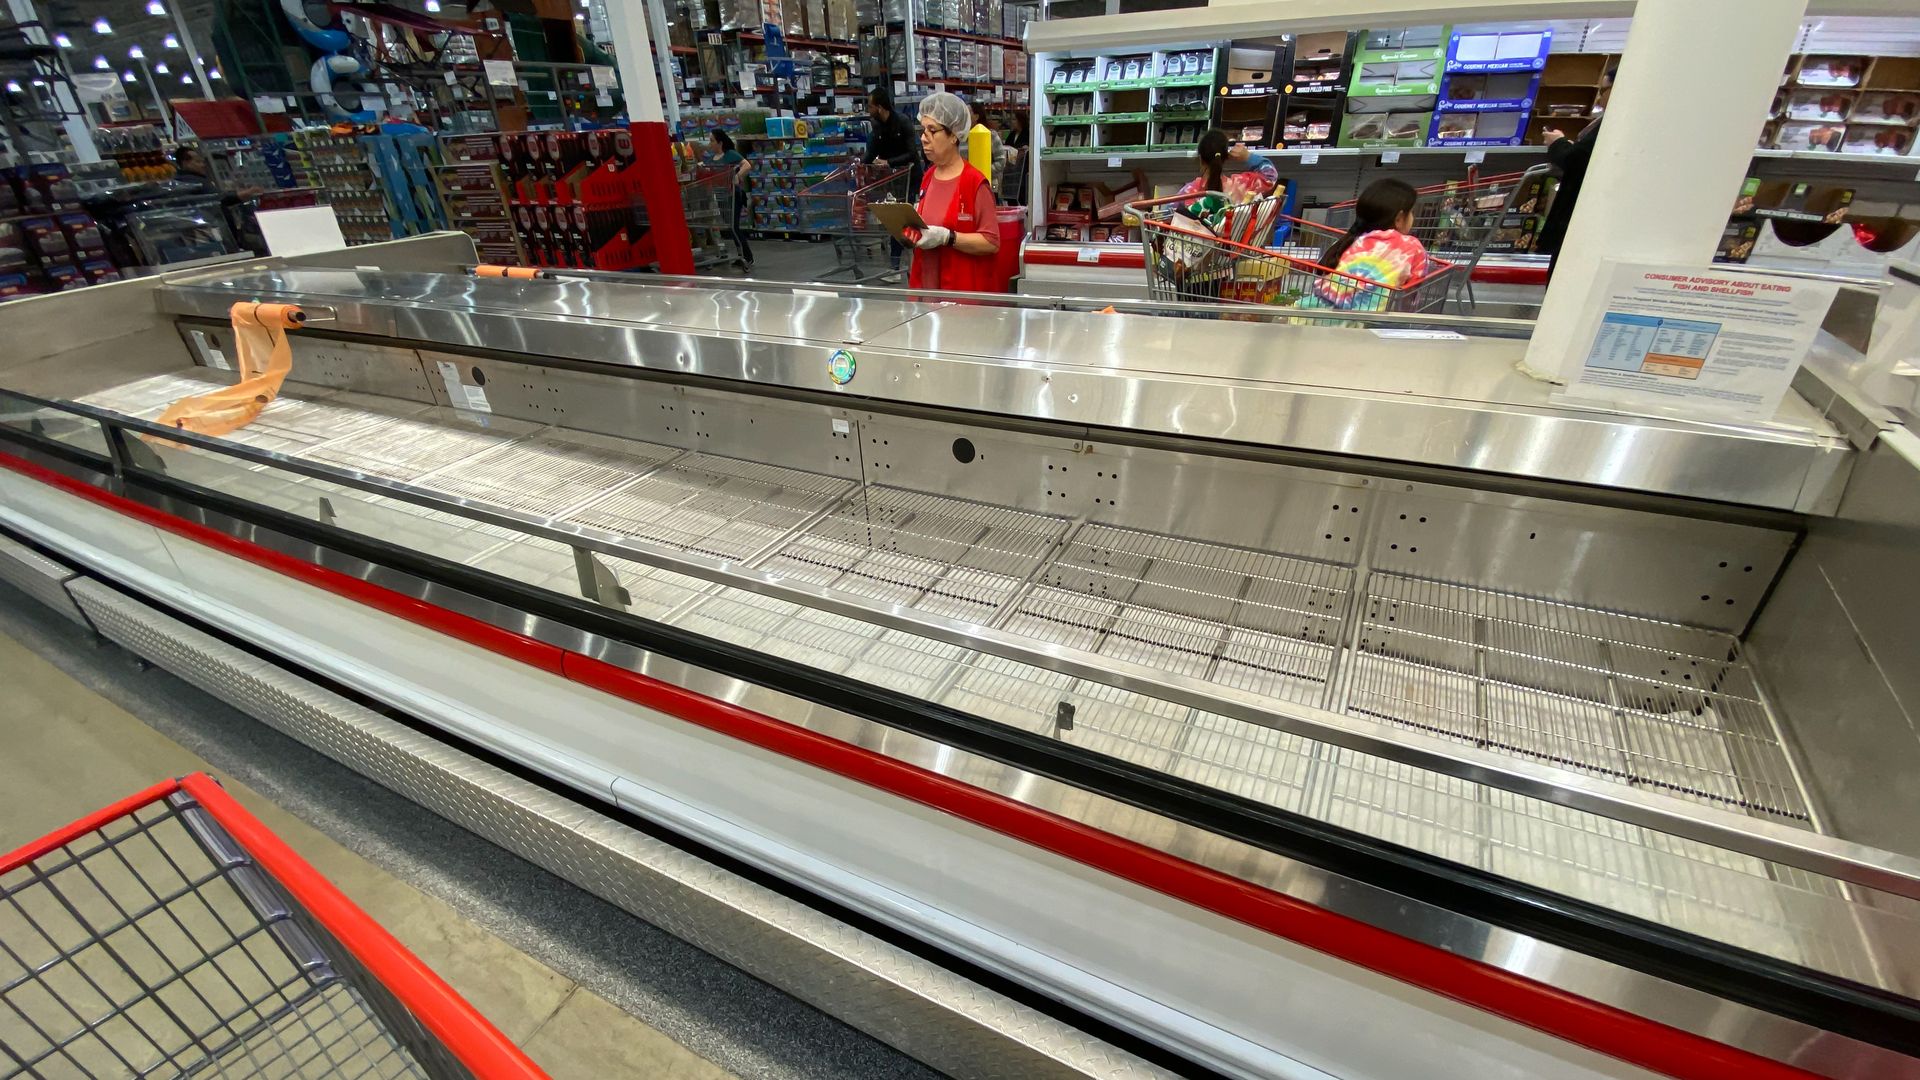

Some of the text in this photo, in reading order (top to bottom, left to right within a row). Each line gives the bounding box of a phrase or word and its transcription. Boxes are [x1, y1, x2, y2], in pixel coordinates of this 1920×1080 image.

[1644, 273, 1791, 293] CONSUMER ADVISORY ABOUT EATING
[1710, 287, 1754, 296] SHELLFISH
